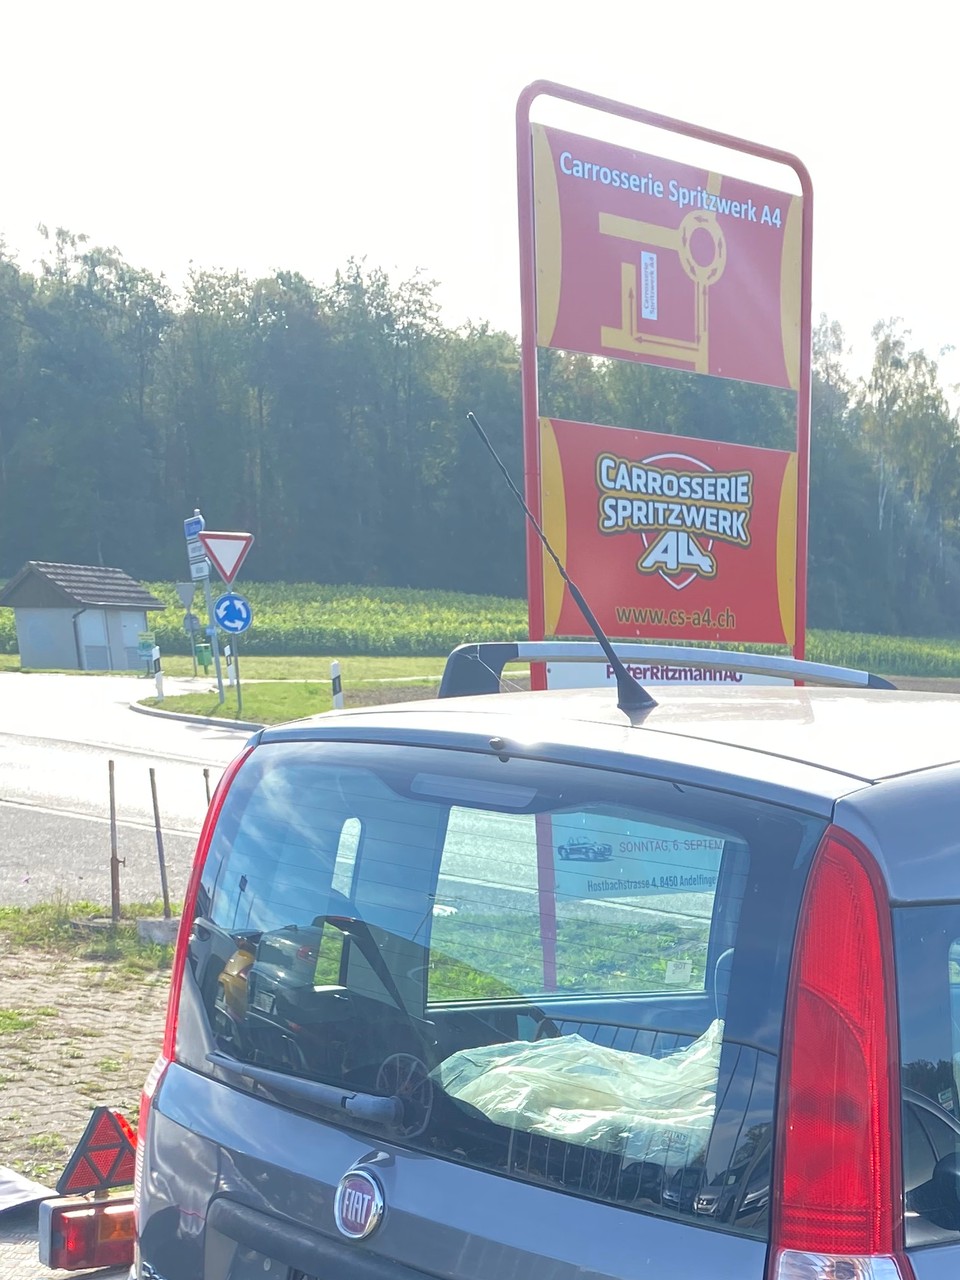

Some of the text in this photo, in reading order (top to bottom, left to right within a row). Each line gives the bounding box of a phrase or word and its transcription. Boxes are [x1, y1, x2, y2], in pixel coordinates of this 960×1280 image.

[560, 151, 782, 228] Carrosserie Spritzwerk A4
[601, 458, 749, 503] CARROSSERIE
[603, 498, 747, 541] SPRITZWERK
[641, 531, 713, 572] A4
[616, 607, 736, 629] www.cs-a4.ch
[660, 876, 678, 887] 8450
[343, 1188, 372, 1225] FIAT
